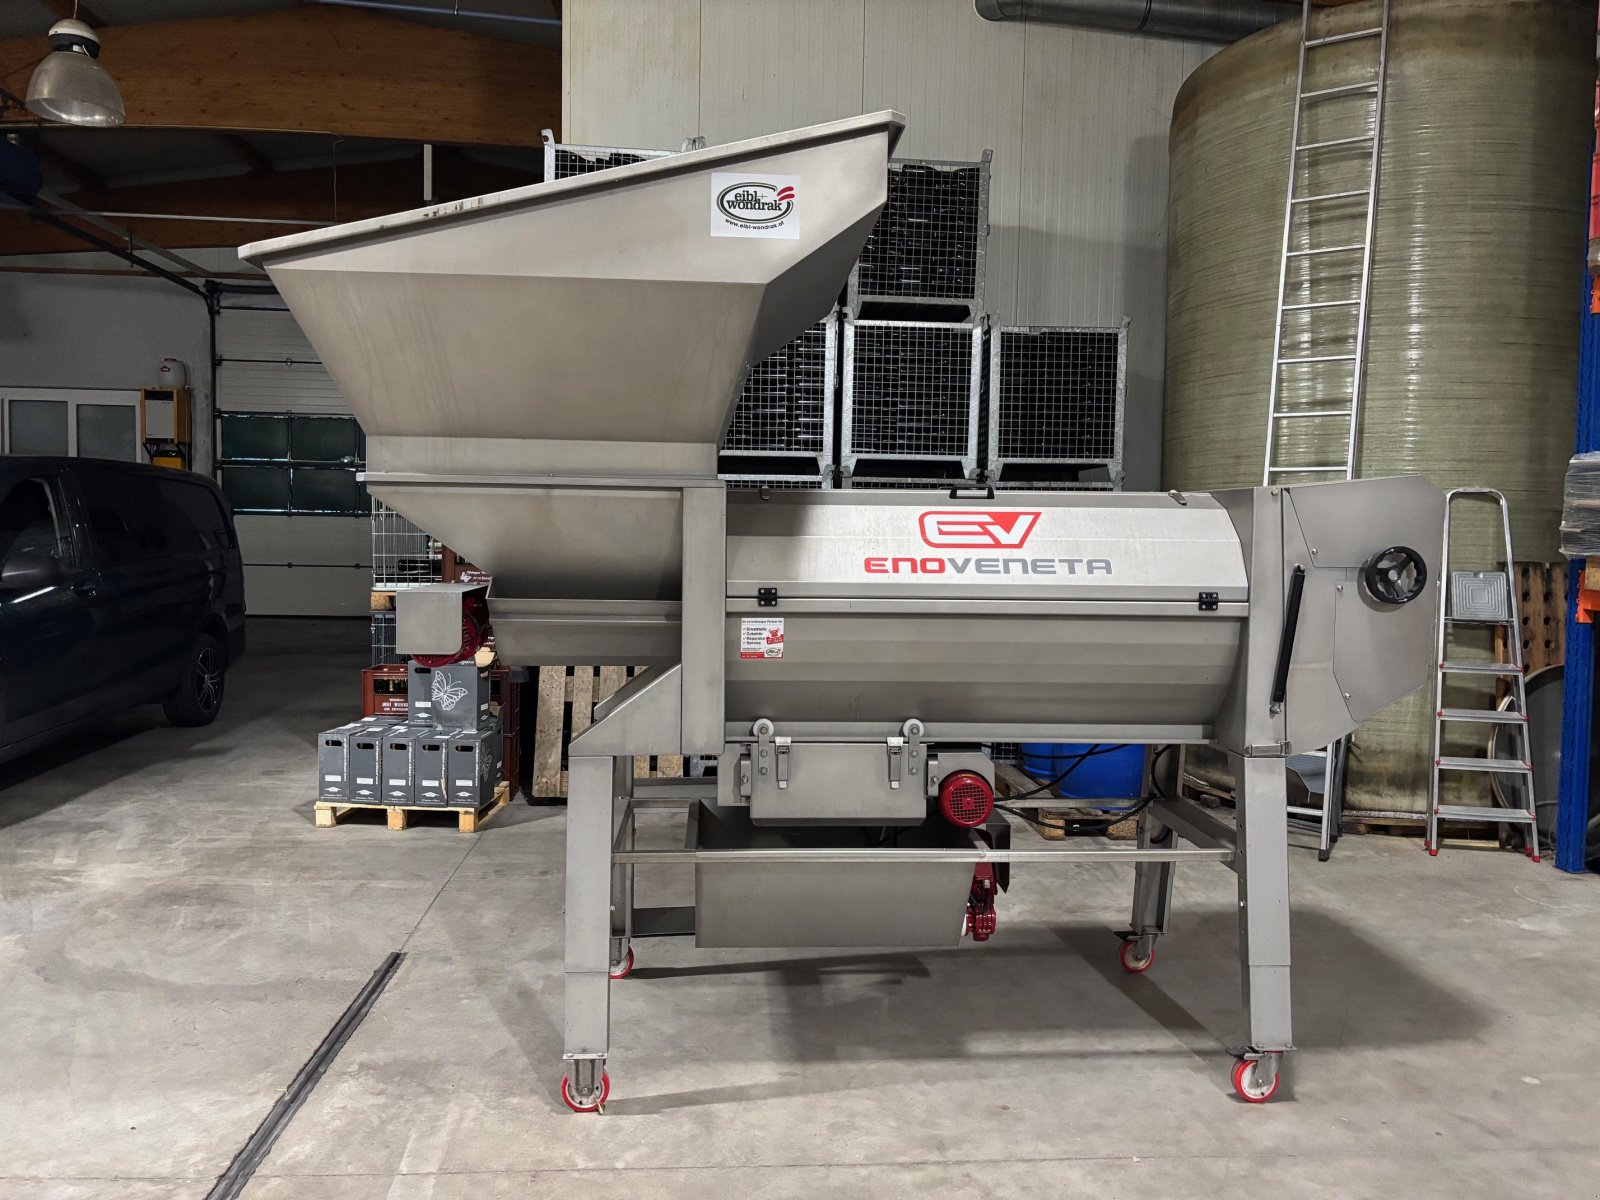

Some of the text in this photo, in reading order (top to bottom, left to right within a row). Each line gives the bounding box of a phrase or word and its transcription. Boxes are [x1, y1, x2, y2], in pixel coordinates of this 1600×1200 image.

[726, 199, 782, 211] wondrak
[725, 219, 784, 230] www.eibl-wondrak.at
[864, 557, 1113, 575] ENOVENETA
